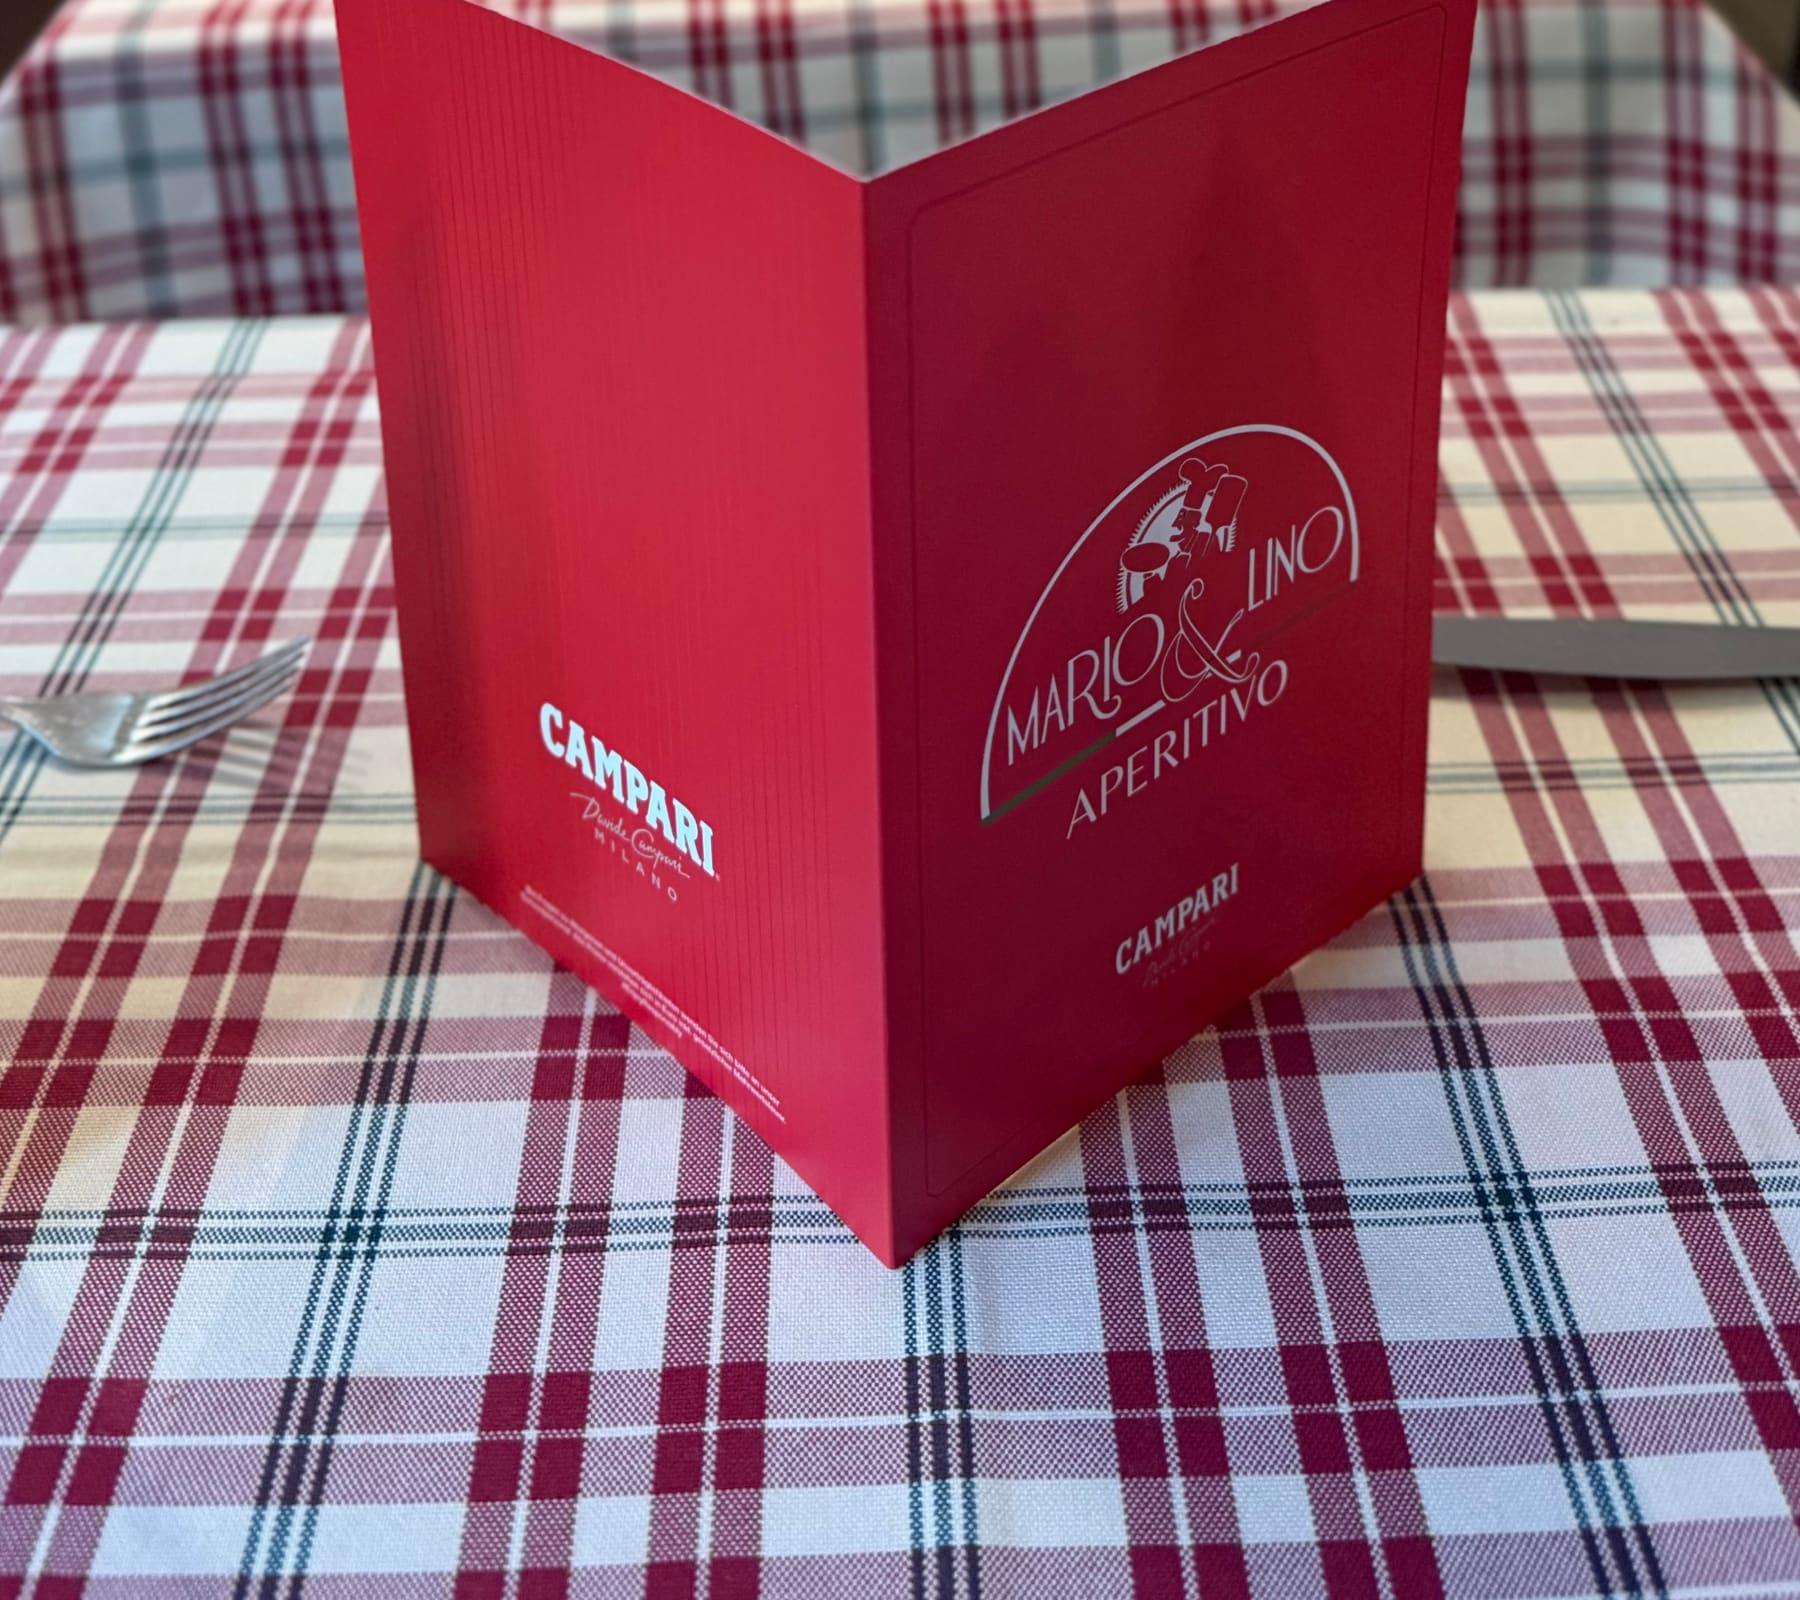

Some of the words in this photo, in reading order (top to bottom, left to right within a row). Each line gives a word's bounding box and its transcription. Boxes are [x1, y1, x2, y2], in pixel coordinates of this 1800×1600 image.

[1007, 613, 1164, 767] MARIO
[1160, 577, 1260, 705] &
[1247, 505, 1345, 612] LINO
[538, 702, 715, 878] CAMPARI
[1066, 659, 1289, 840] APERITIVO
[593, 831, 679, 902] MILANO
[1114, 862, 1240, 976] CAMPARI
